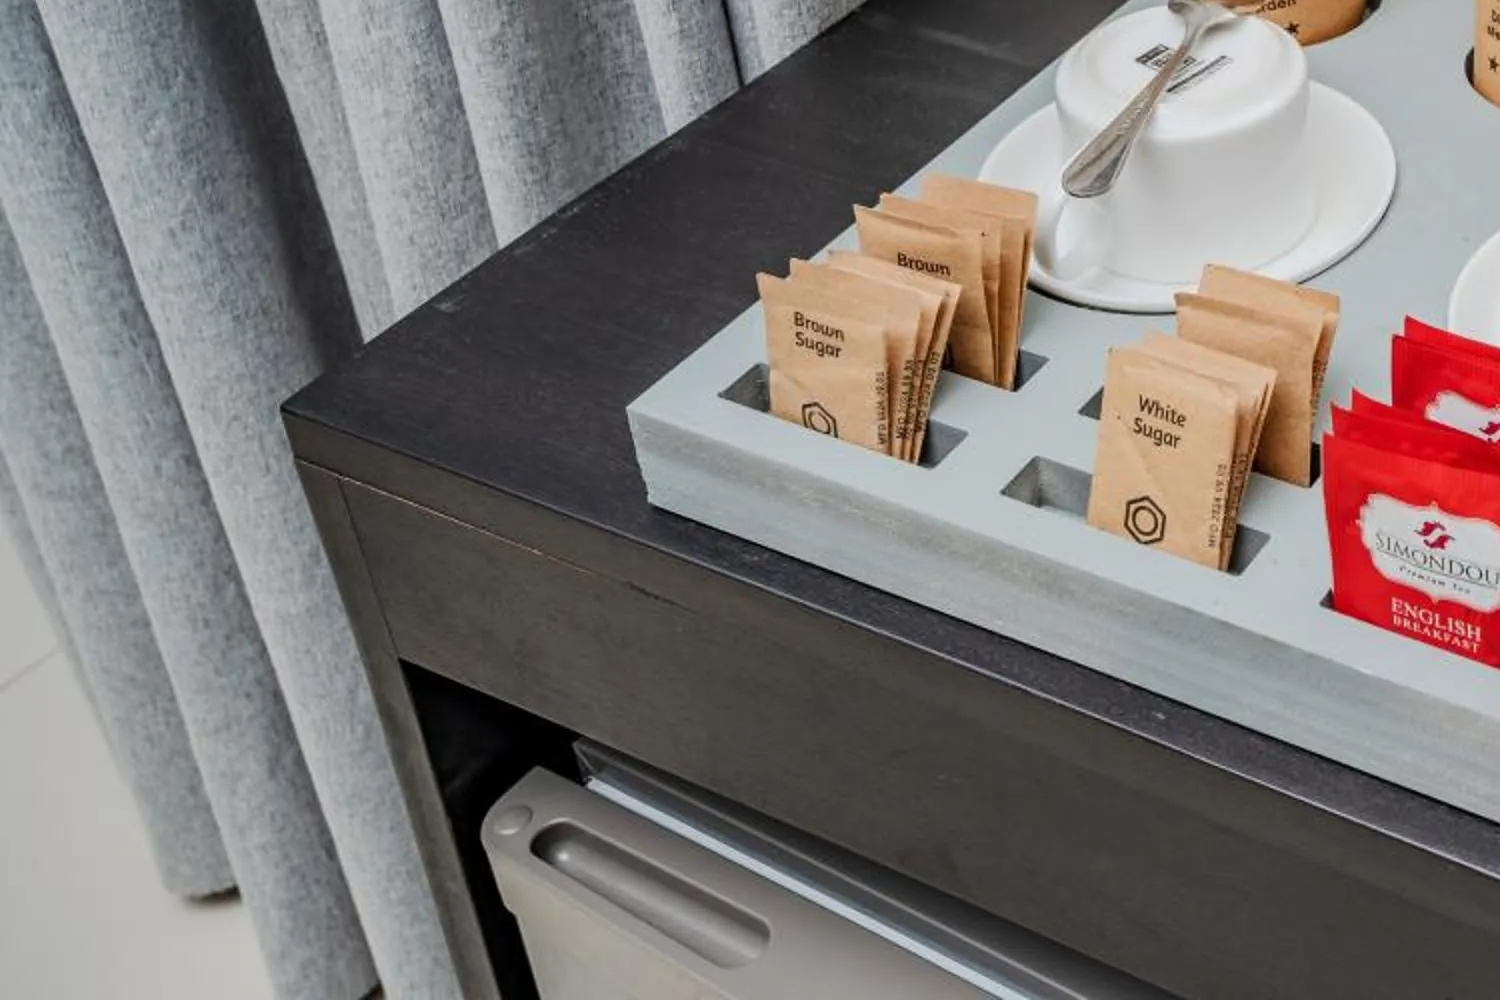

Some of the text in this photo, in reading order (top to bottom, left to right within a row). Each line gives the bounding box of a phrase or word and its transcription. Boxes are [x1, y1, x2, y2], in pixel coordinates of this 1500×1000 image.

[897, 252, 951, 276] Brown
[793, 311, 845, 342] Brown
[794, 331, 844, 359] Sugar
[1138, 394, 1187, 429] White
[1132, 417, 1182, 449] Sugar
[1391, 597, 1483, 643] ENGLISH
[1392, 615, 1481, 653] BREAKFAST
